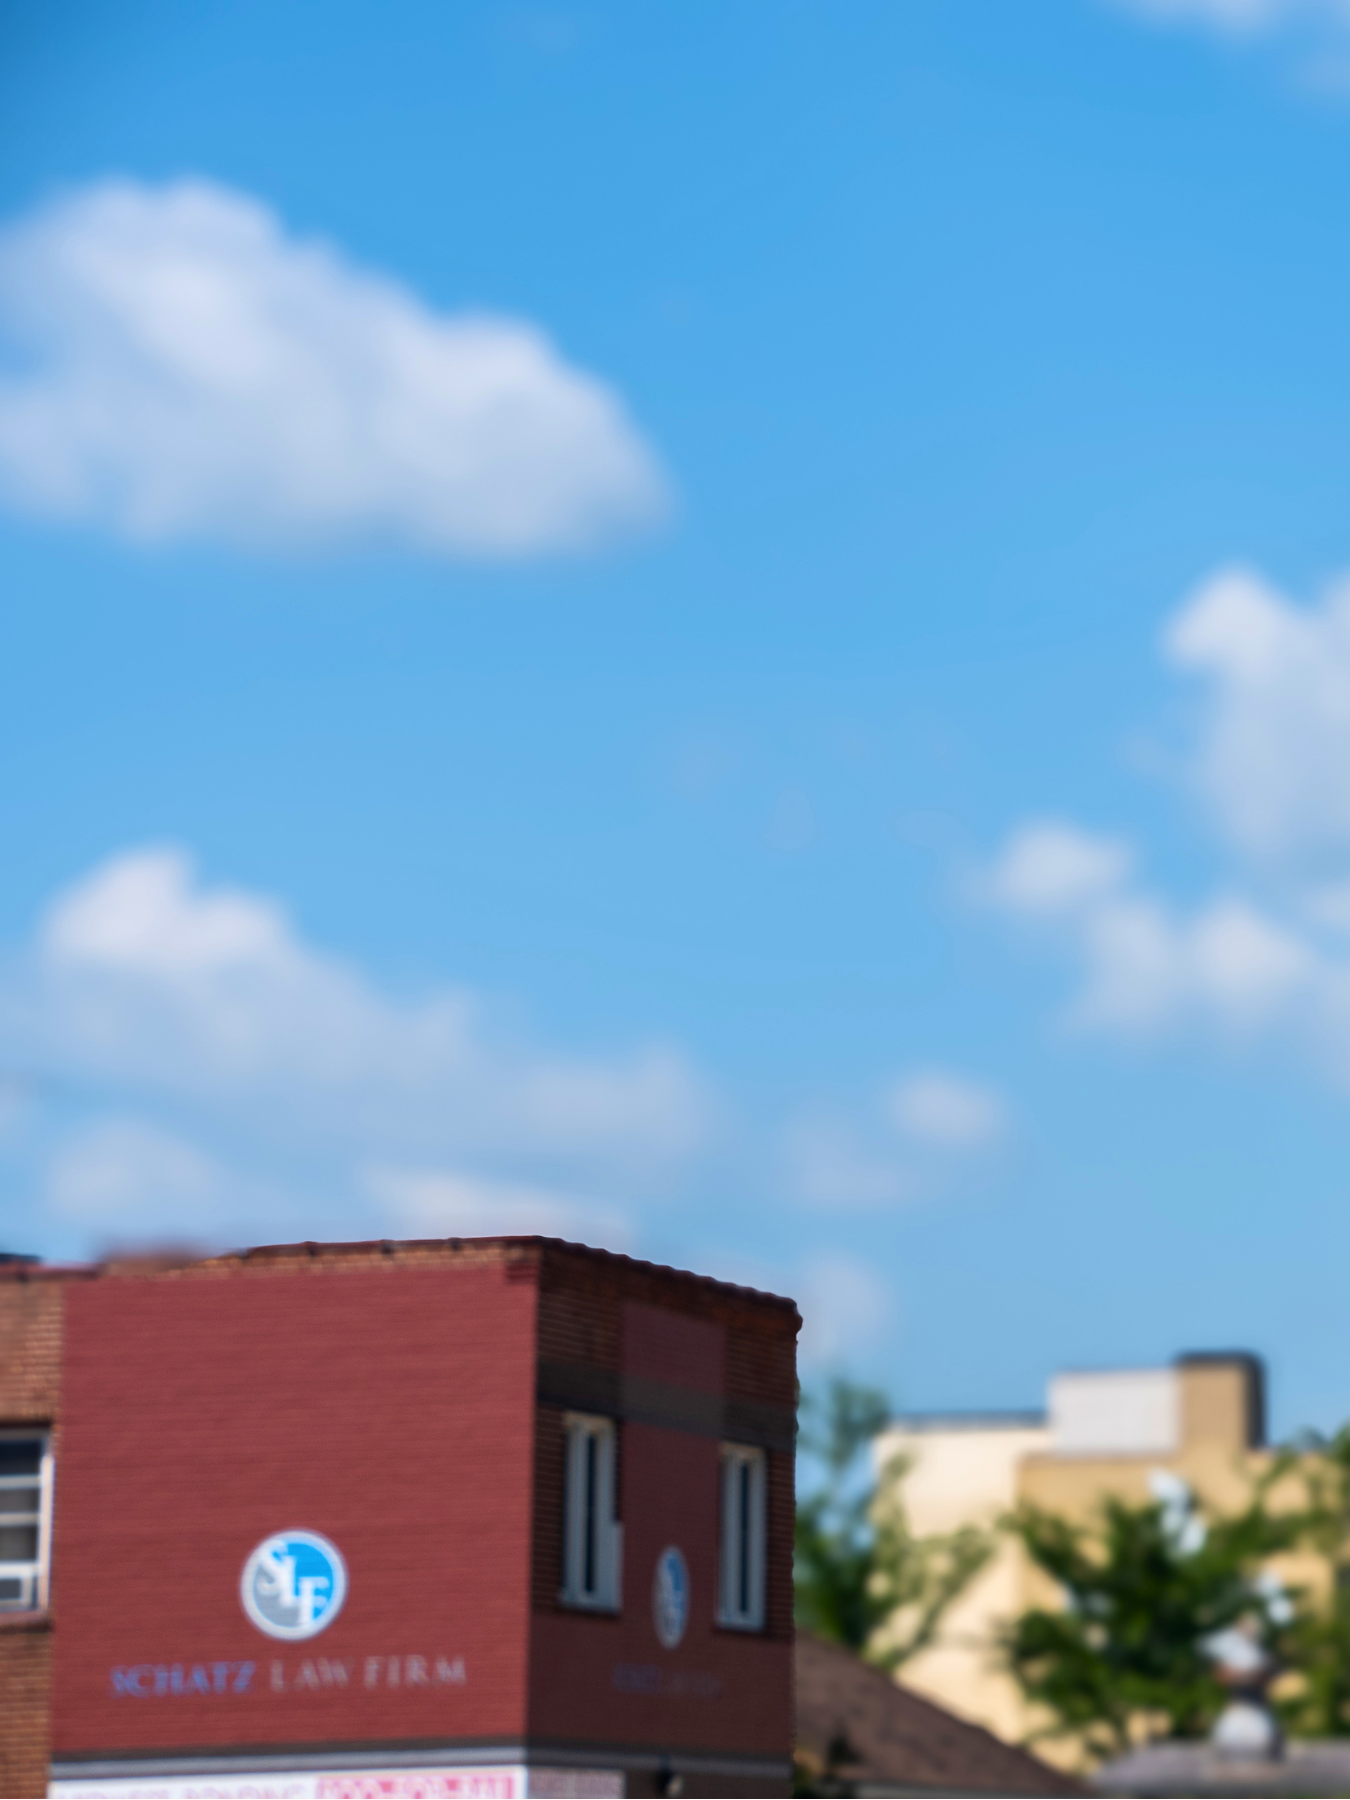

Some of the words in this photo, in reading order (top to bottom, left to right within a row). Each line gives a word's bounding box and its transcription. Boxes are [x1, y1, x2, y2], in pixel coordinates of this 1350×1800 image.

[109, 1660, 257, 1697] SCHATZ
[270, 1658, 356, 1693] LAW
[363, 1653, 467, 1690] FIRM
